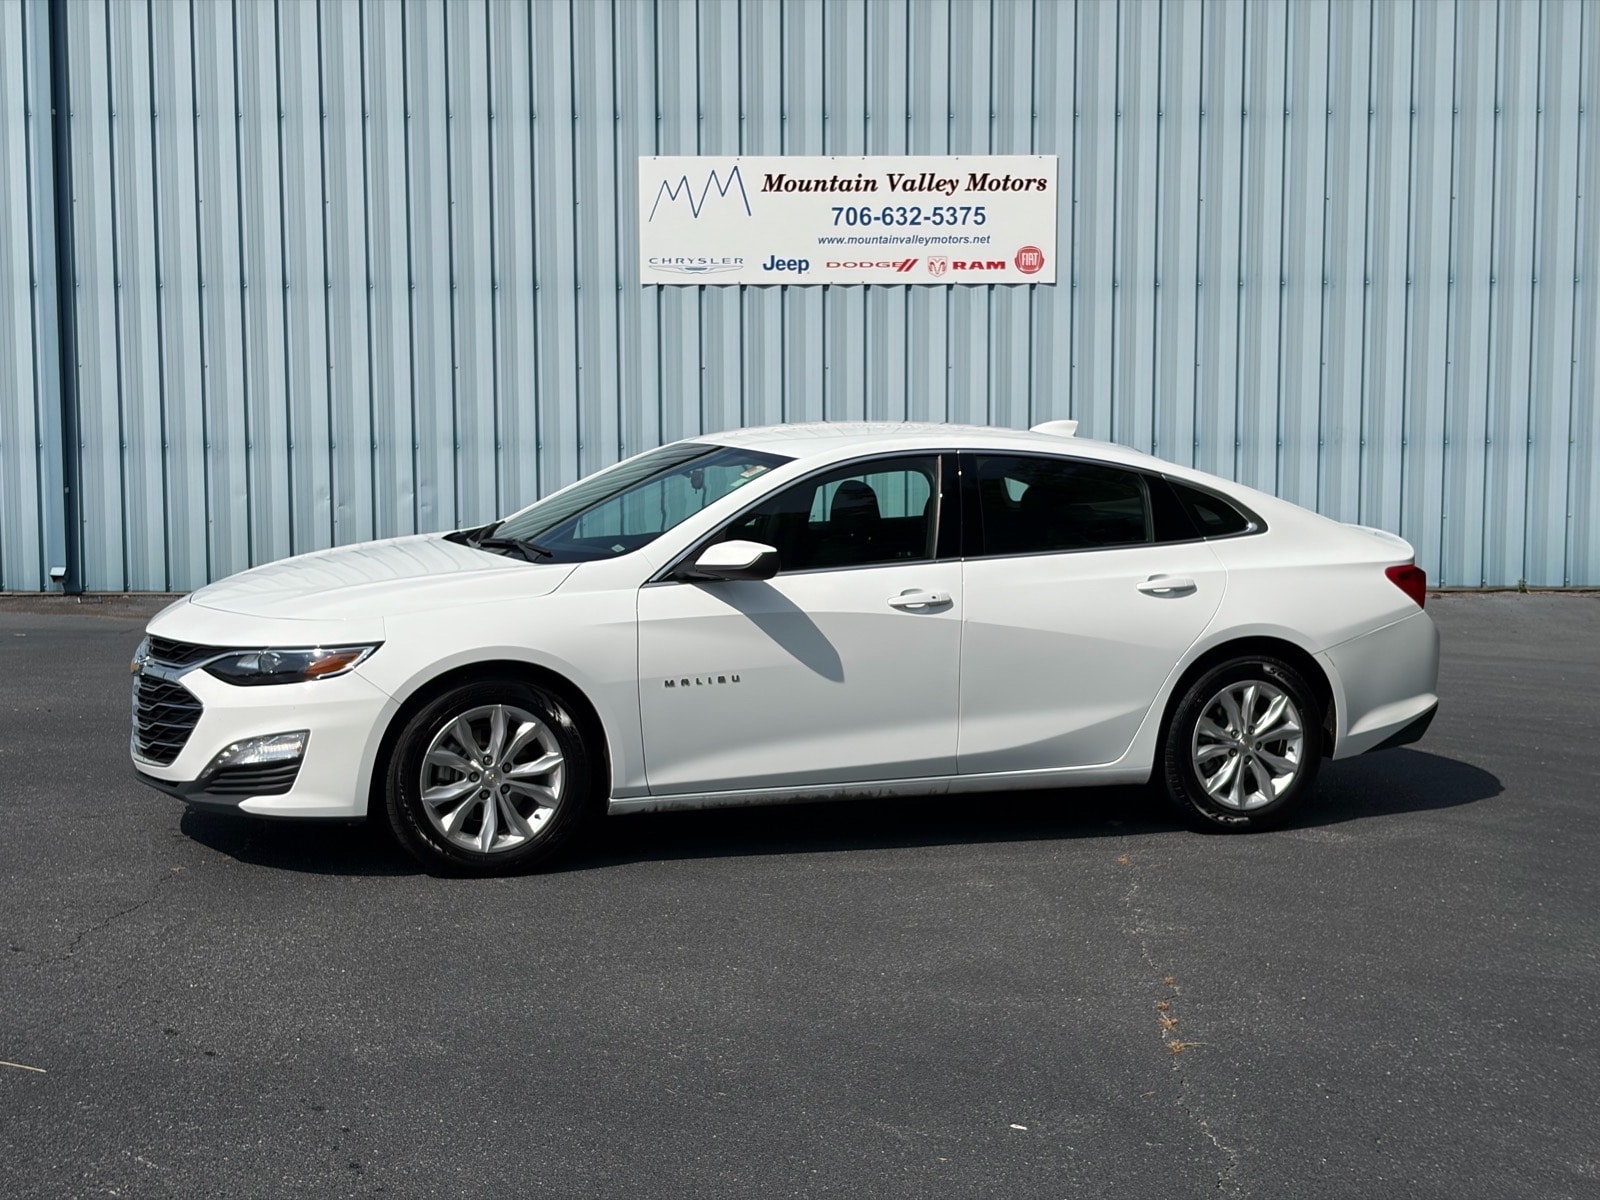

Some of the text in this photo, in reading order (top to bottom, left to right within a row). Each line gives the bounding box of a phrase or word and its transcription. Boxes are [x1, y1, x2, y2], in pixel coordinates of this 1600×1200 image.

[761, 173, 1047, 196] Mountain Valley Motors
[831, 206, 986, 226] 706-632-5375
[818, 235, 990, 246] www.mountainvalleymotors.net
[648, 257, 744, 265] CHRYSLER
[763, 255, 810, 274] Jeep
[952, 261, 1006, 270] RAM
[1021, 252, 1038, 266] FIAT
[664, 674, 741, 688] MALIBU
